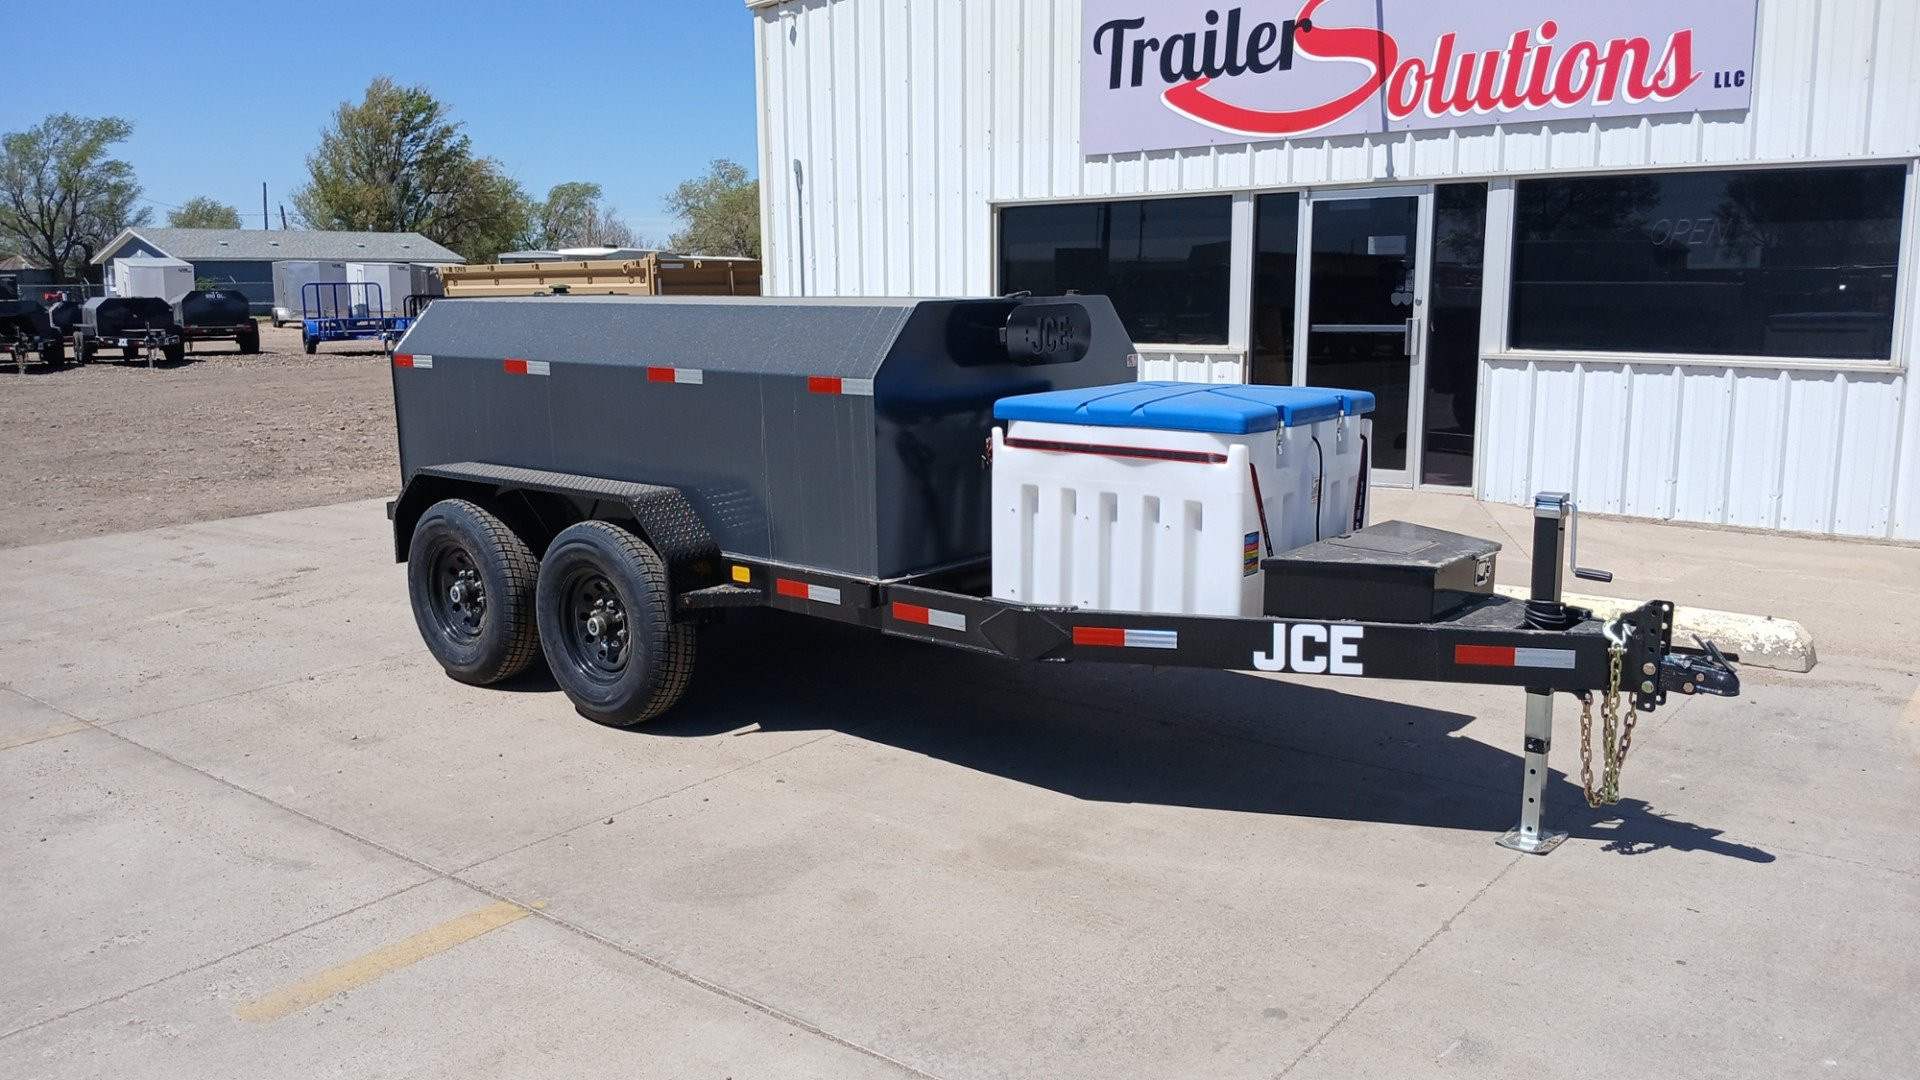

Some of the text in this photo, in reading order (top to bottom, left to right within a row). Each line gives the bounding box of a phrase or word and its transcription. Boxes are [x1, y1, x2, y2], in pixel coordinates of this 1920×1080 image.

[1093, 0, 1745, 137] Trailer Solutions LLC
[1651, 218, 1733, 245] OPEN
[1253, 623, 1364, 675] JCE
